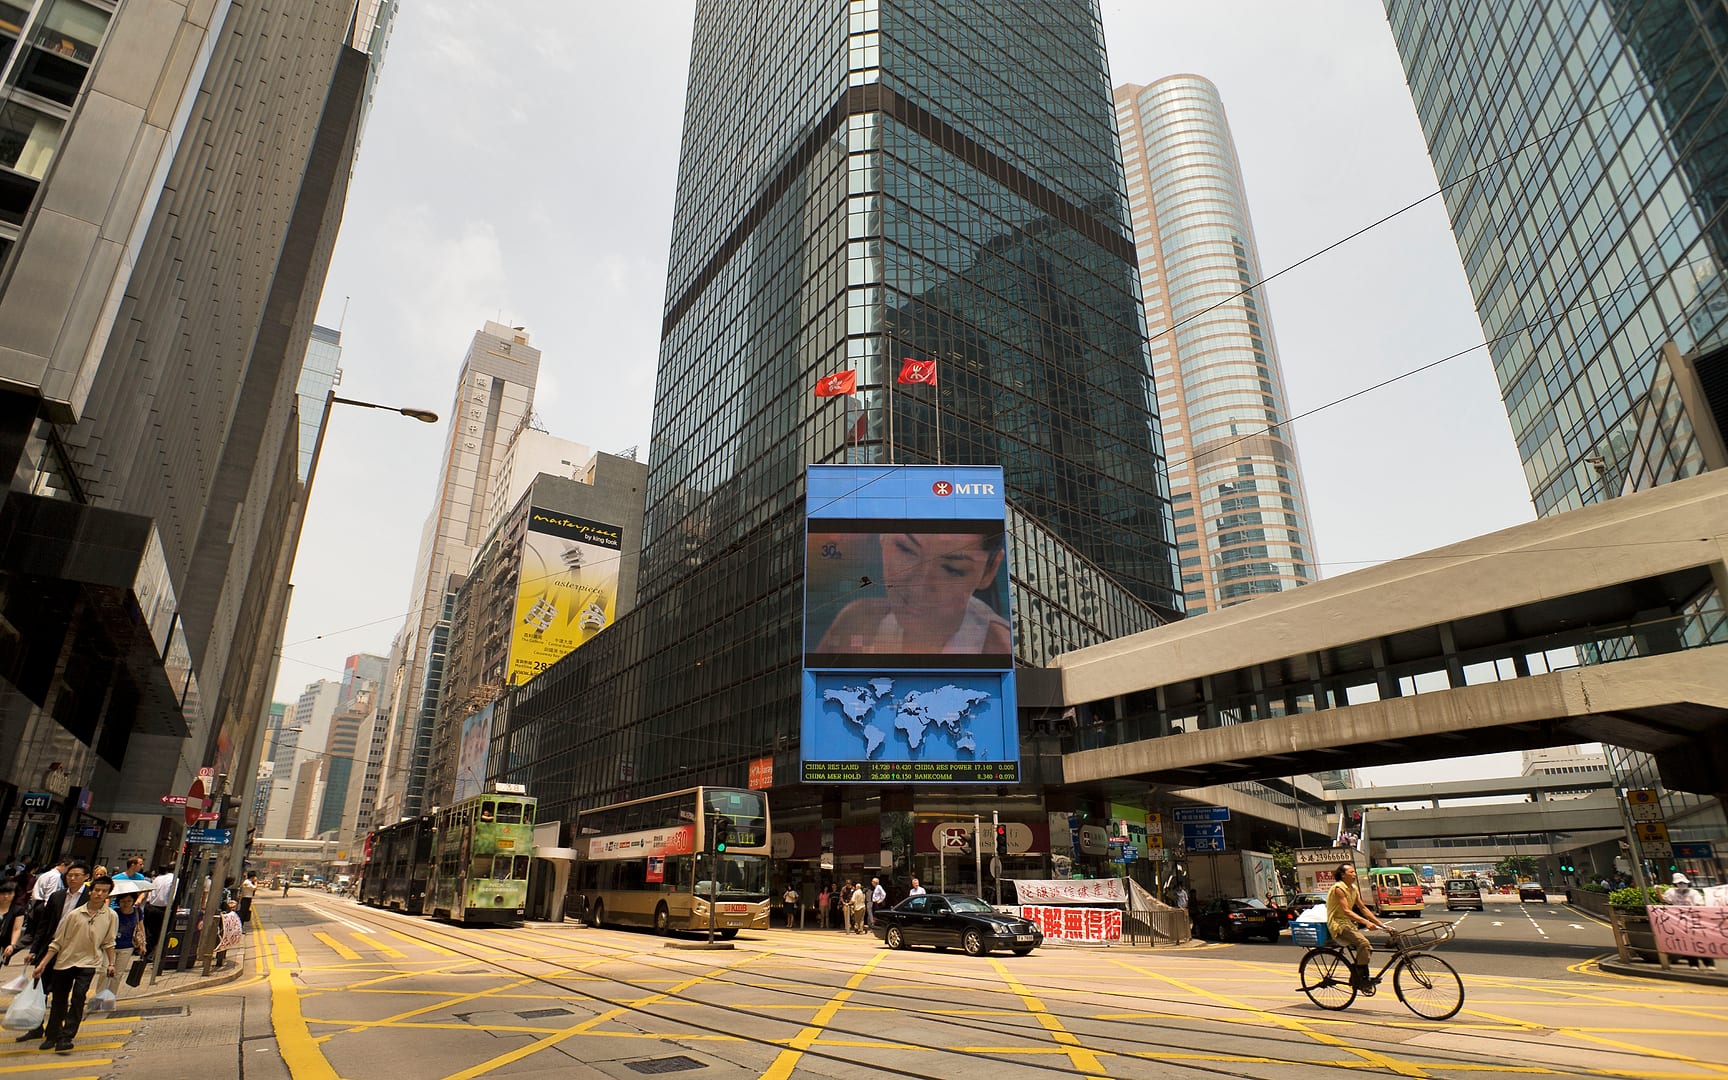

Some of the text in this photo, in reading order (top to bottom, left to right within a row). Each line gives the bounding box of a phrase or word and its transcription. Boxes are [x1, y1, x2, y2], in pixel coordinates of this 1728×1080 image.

[954, 483, 995, 495] MTR
[533, 514, 618, 538] masterpiece
[584, 533, 592, 541] by
[592, 535, 604, 544] king
[533, 661, 553, 671] 28
[24, 797, 45, 807] citi
[740, 832, 755, 844] 111
